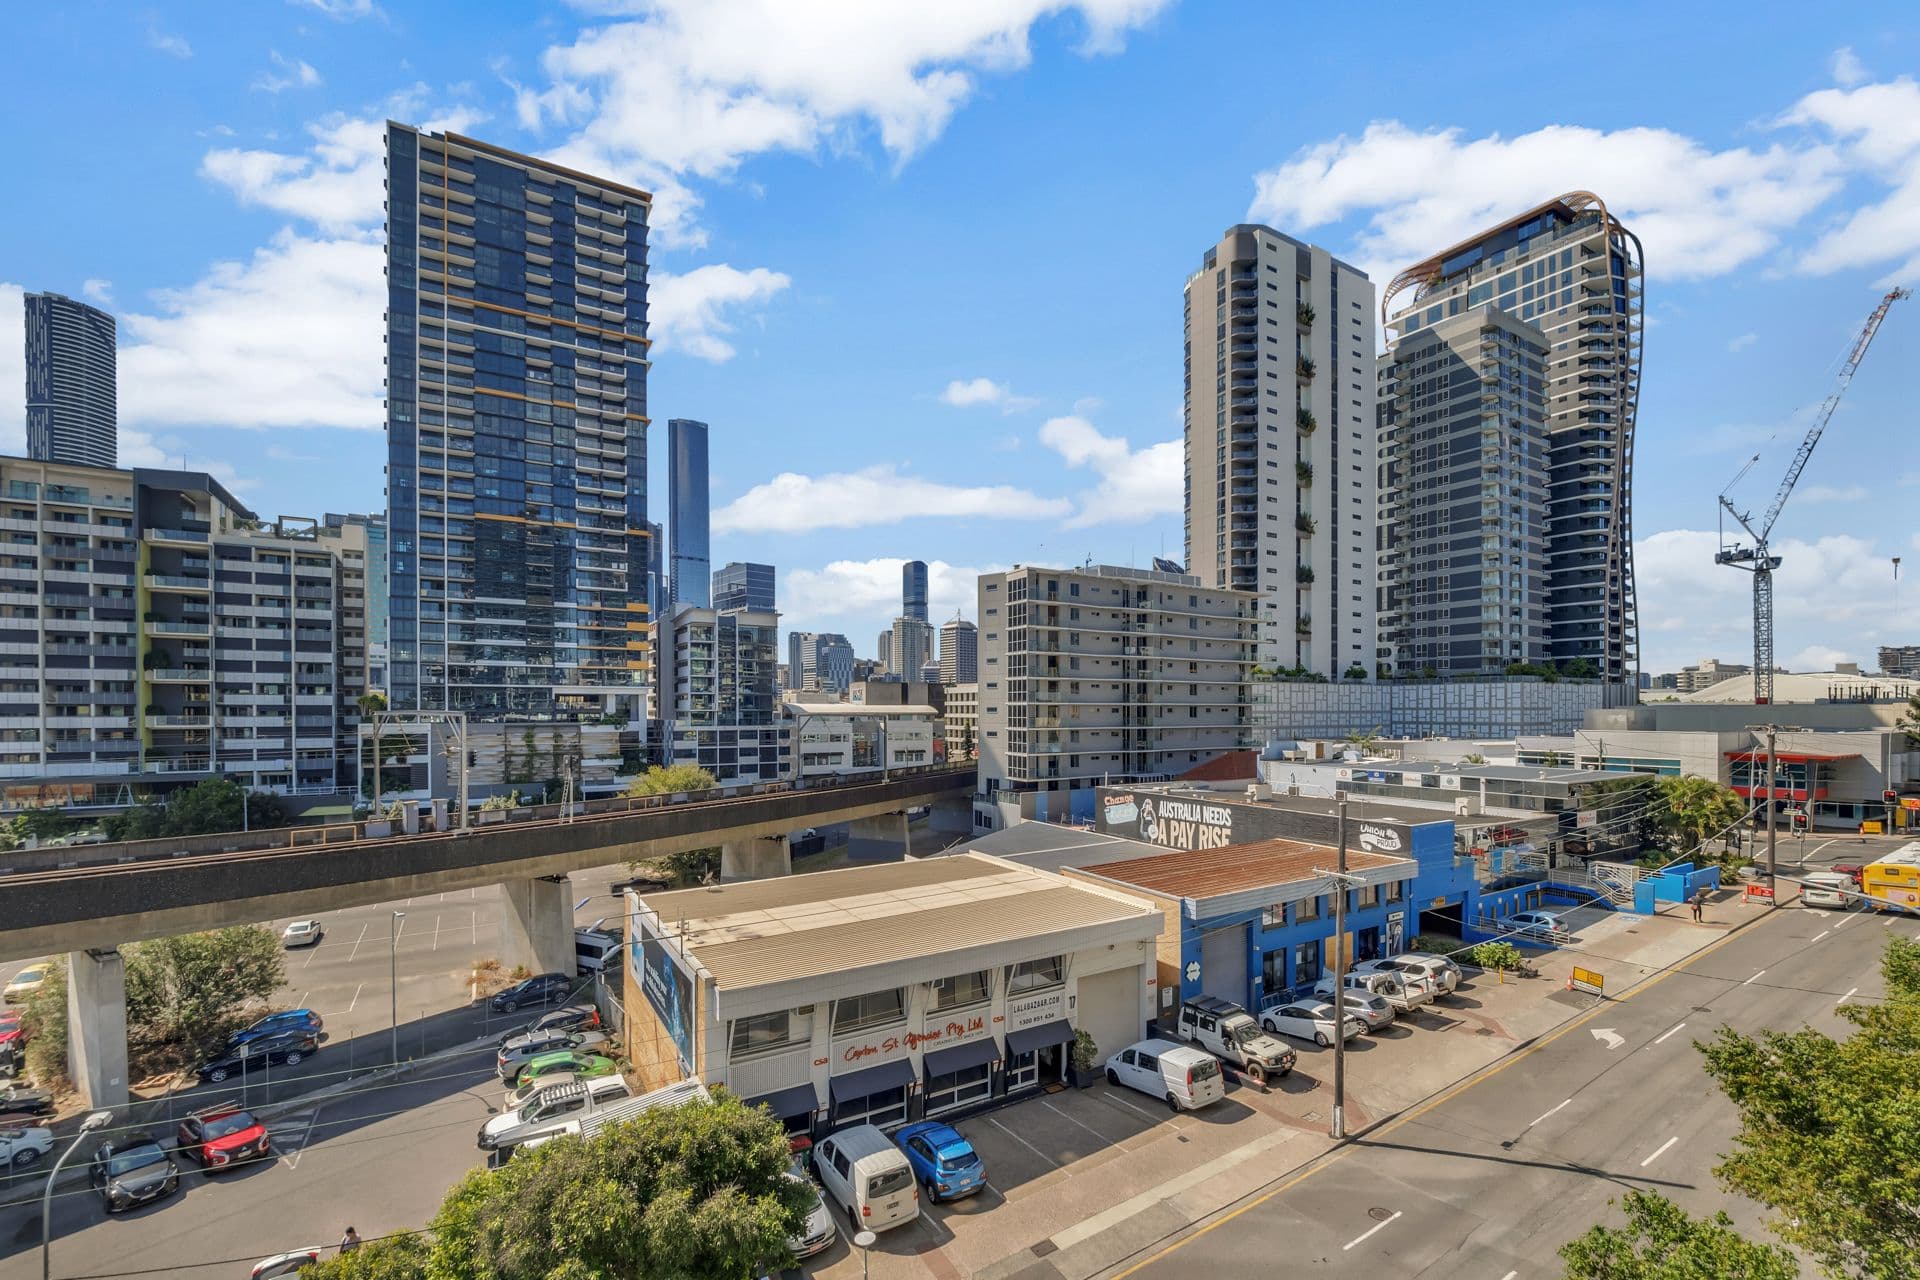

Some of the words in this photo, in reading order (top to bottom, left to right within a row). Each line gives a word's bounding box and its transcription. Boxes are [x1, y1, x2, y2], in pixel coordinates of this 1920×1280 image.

[1104, 794, 1134, 806] Change
[1159, 801, 1202, 822] AUSTRALIA
[1203, 806, 1232, 827] NEEDS
[1158, 819, 1168, 845] A
[1170, 821, 1195, 850] PAY
[1199, 825, 1232, 850] RISE
[1376, 839, 1397, 848] PROUD
[1013, 995, 1060, 1013] LALABAZAAR.COM
[1069, 995, 1076, 1009] 17
[882, 1036, 899, 1053] St
[946, 1021, 965, 1039] Pty
[968, 1016, 984, 1032] Ltd
